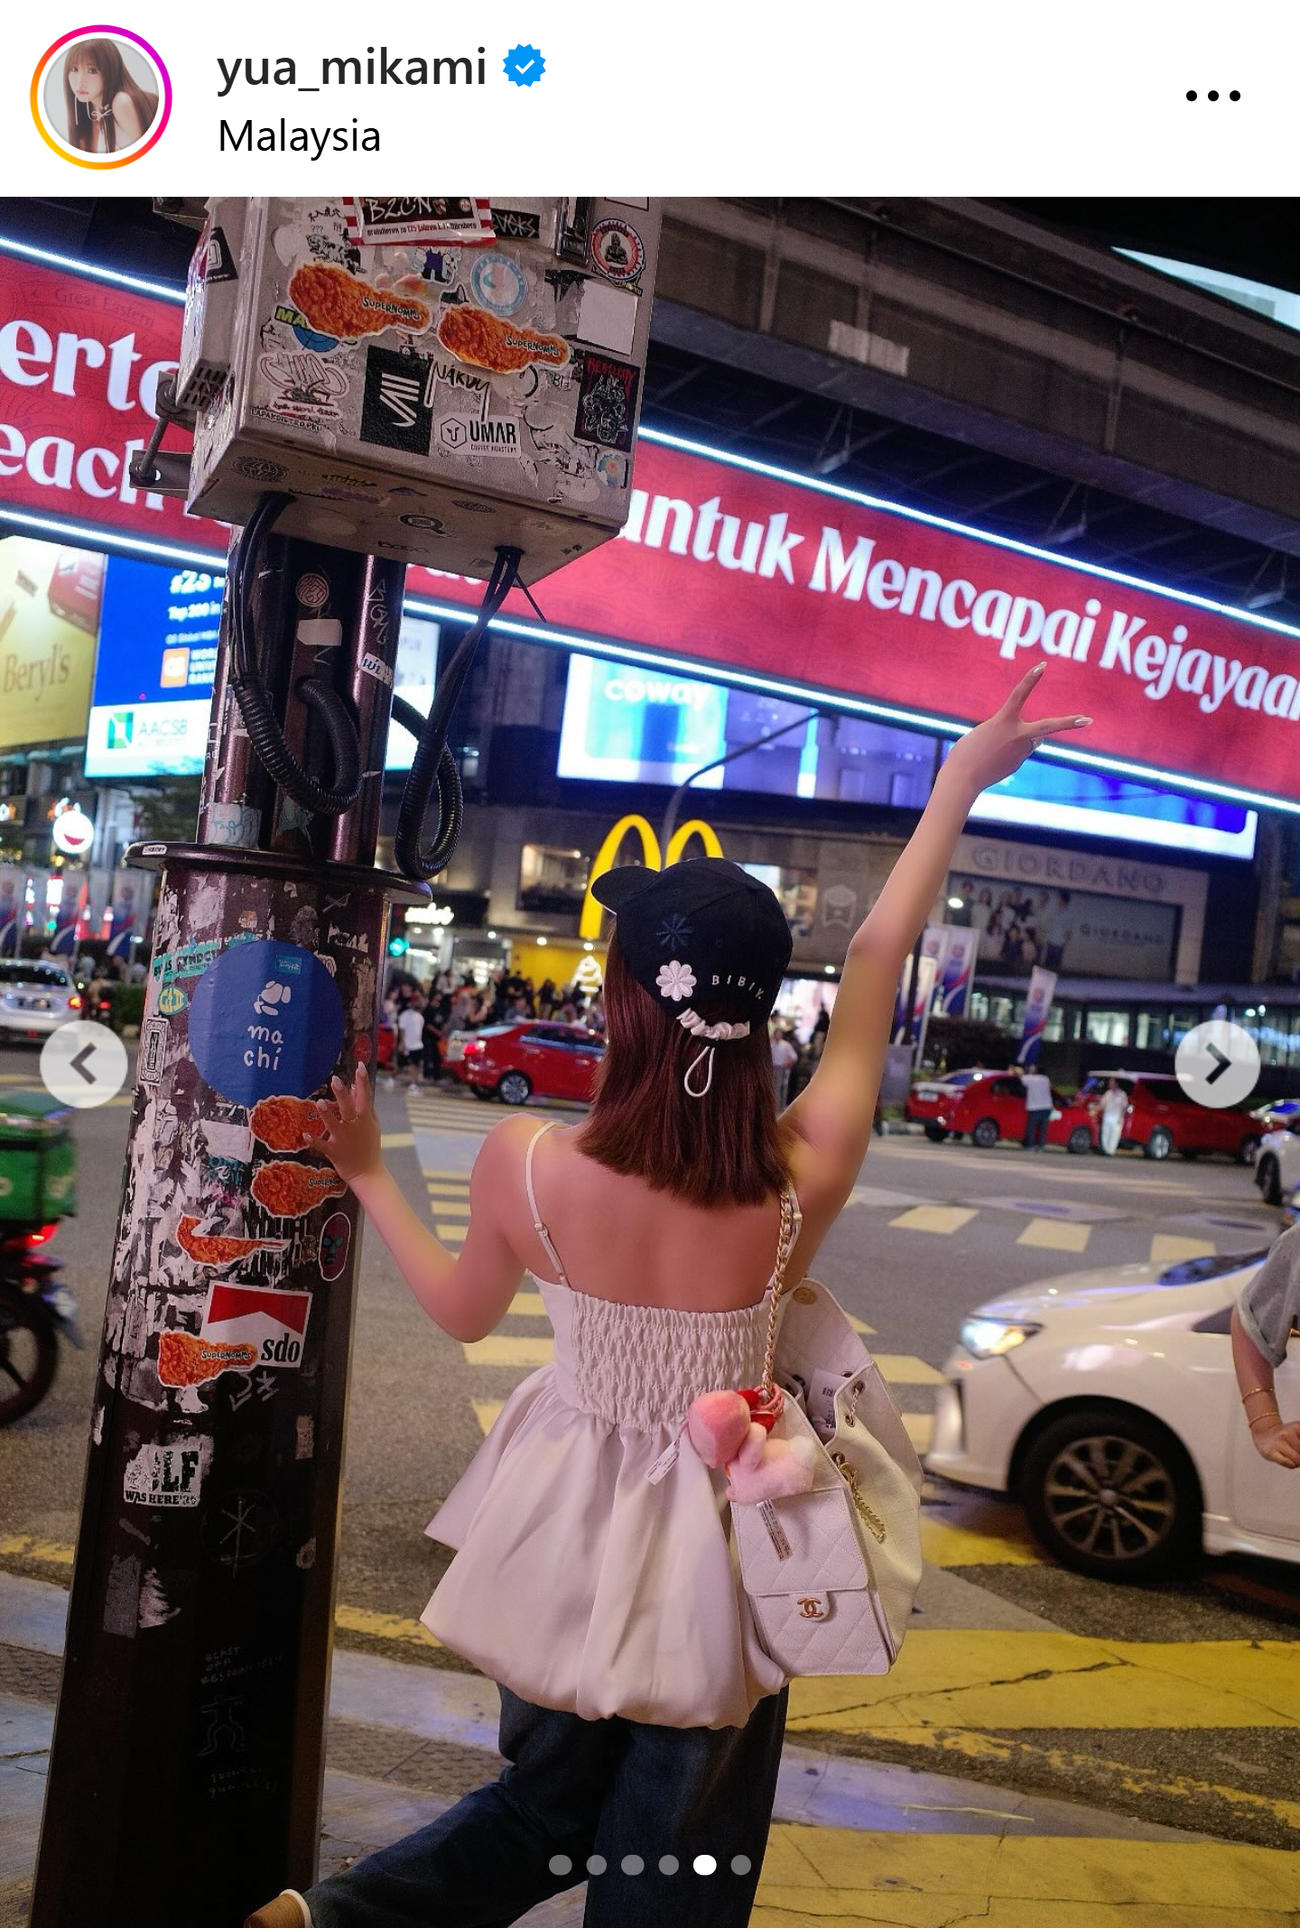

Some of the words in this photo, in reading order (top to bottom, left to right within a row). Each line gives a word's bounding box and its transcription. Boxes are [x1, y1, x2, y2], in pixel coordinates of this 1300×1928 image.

[469, 420, 517, 444] UMAR
[808, 525, 1102, 660] Mencapai
[1098, 610, 1300, 722] Kejayaa
[3, 642, 72, 702] Beryl's
[604, 679, 711, 711] coway
[971, 847, 1166, 893] GIORDANO
[248, 1024, 284, 1044] ma
[243, 1046, 282, 1071] chi
[261, 1333, 300, 1363] sdo
[125, 1490, 147, 1503] WAS
[148, 1494, 180, 1505] HERE
